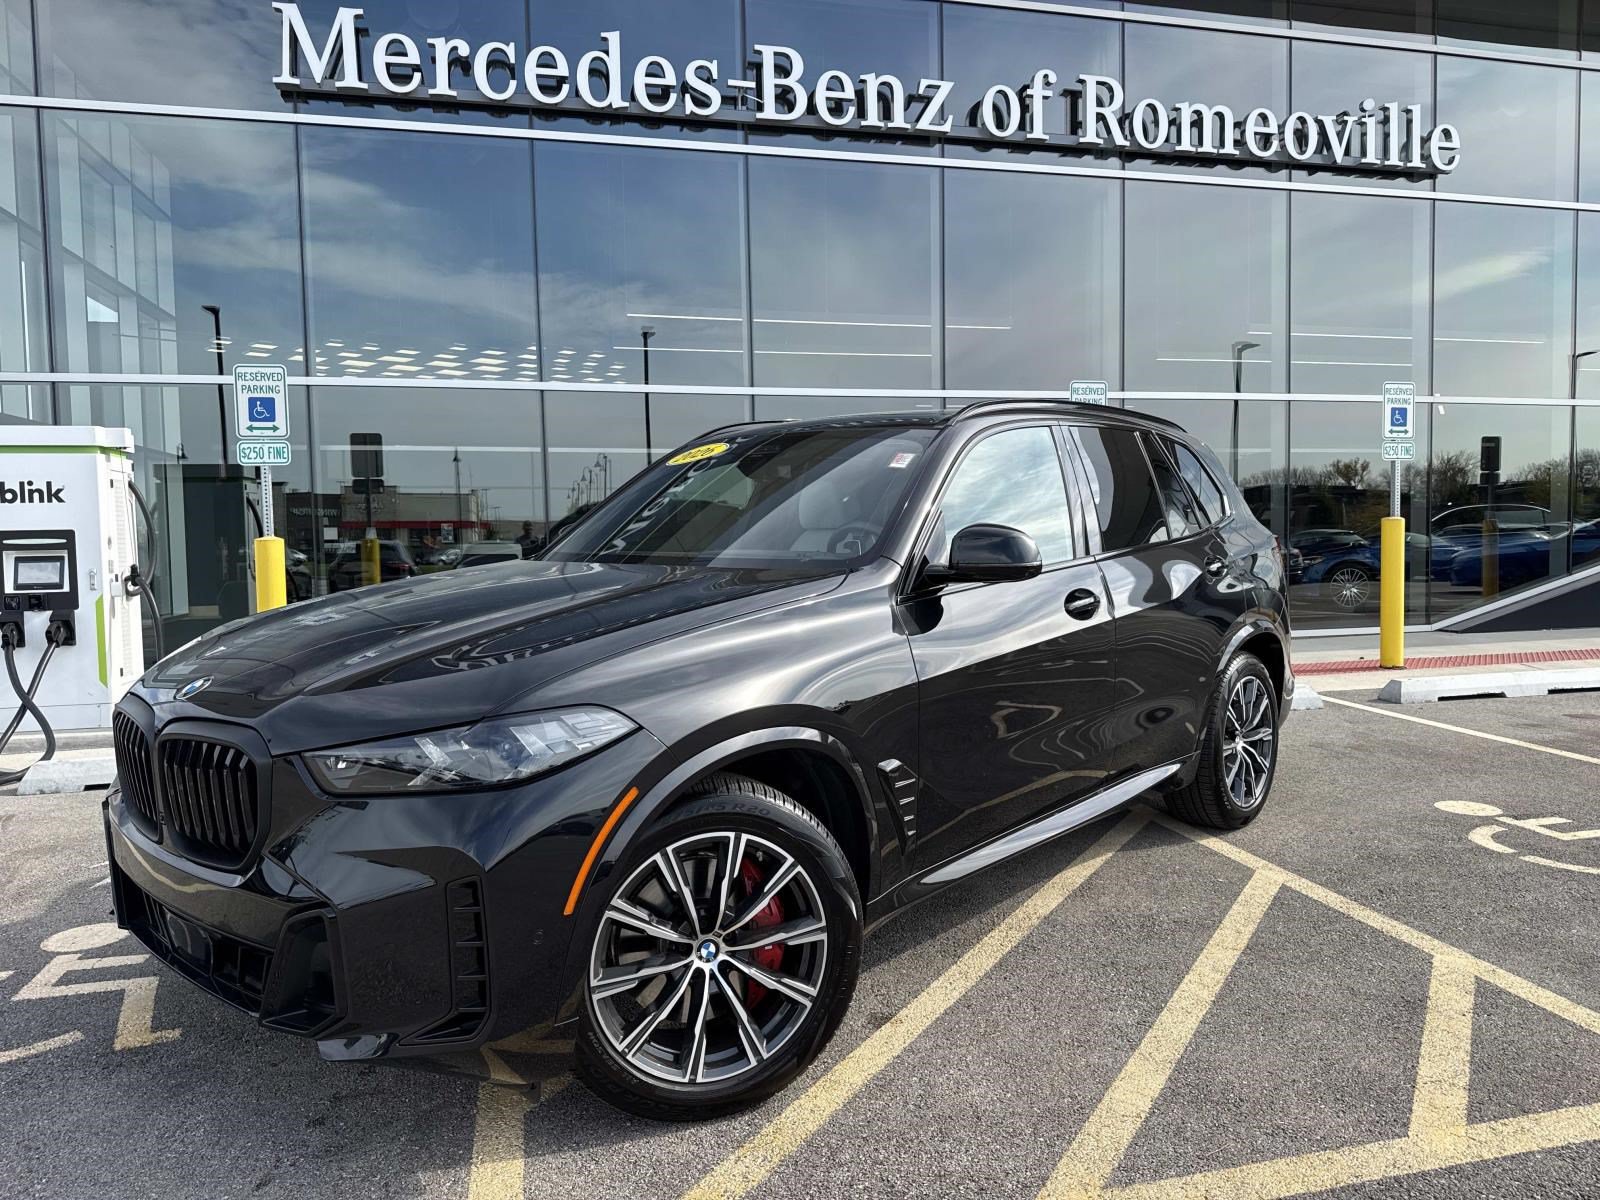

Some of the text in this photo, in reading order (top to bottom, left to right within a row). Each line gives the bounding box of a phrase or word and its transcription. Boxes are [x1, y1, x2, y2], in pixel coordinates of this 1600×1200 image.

[272, 2, 1461, 172] Mercedes-Benz of Romeoville
[237, 372, 283, 382] RESERVED
[241, 385, 281, 394] PARKING
[1072, 387, 1105, 396] RESERVED
[1385, 388, 1413, 396] RESERVED
[1387, 397, 1412, 405] PARKING
[241, 447, 287, 460] $250 FINE
[1384, 446, 1413, 457] $250 FINE
[0, 480, 66, 504] blink
